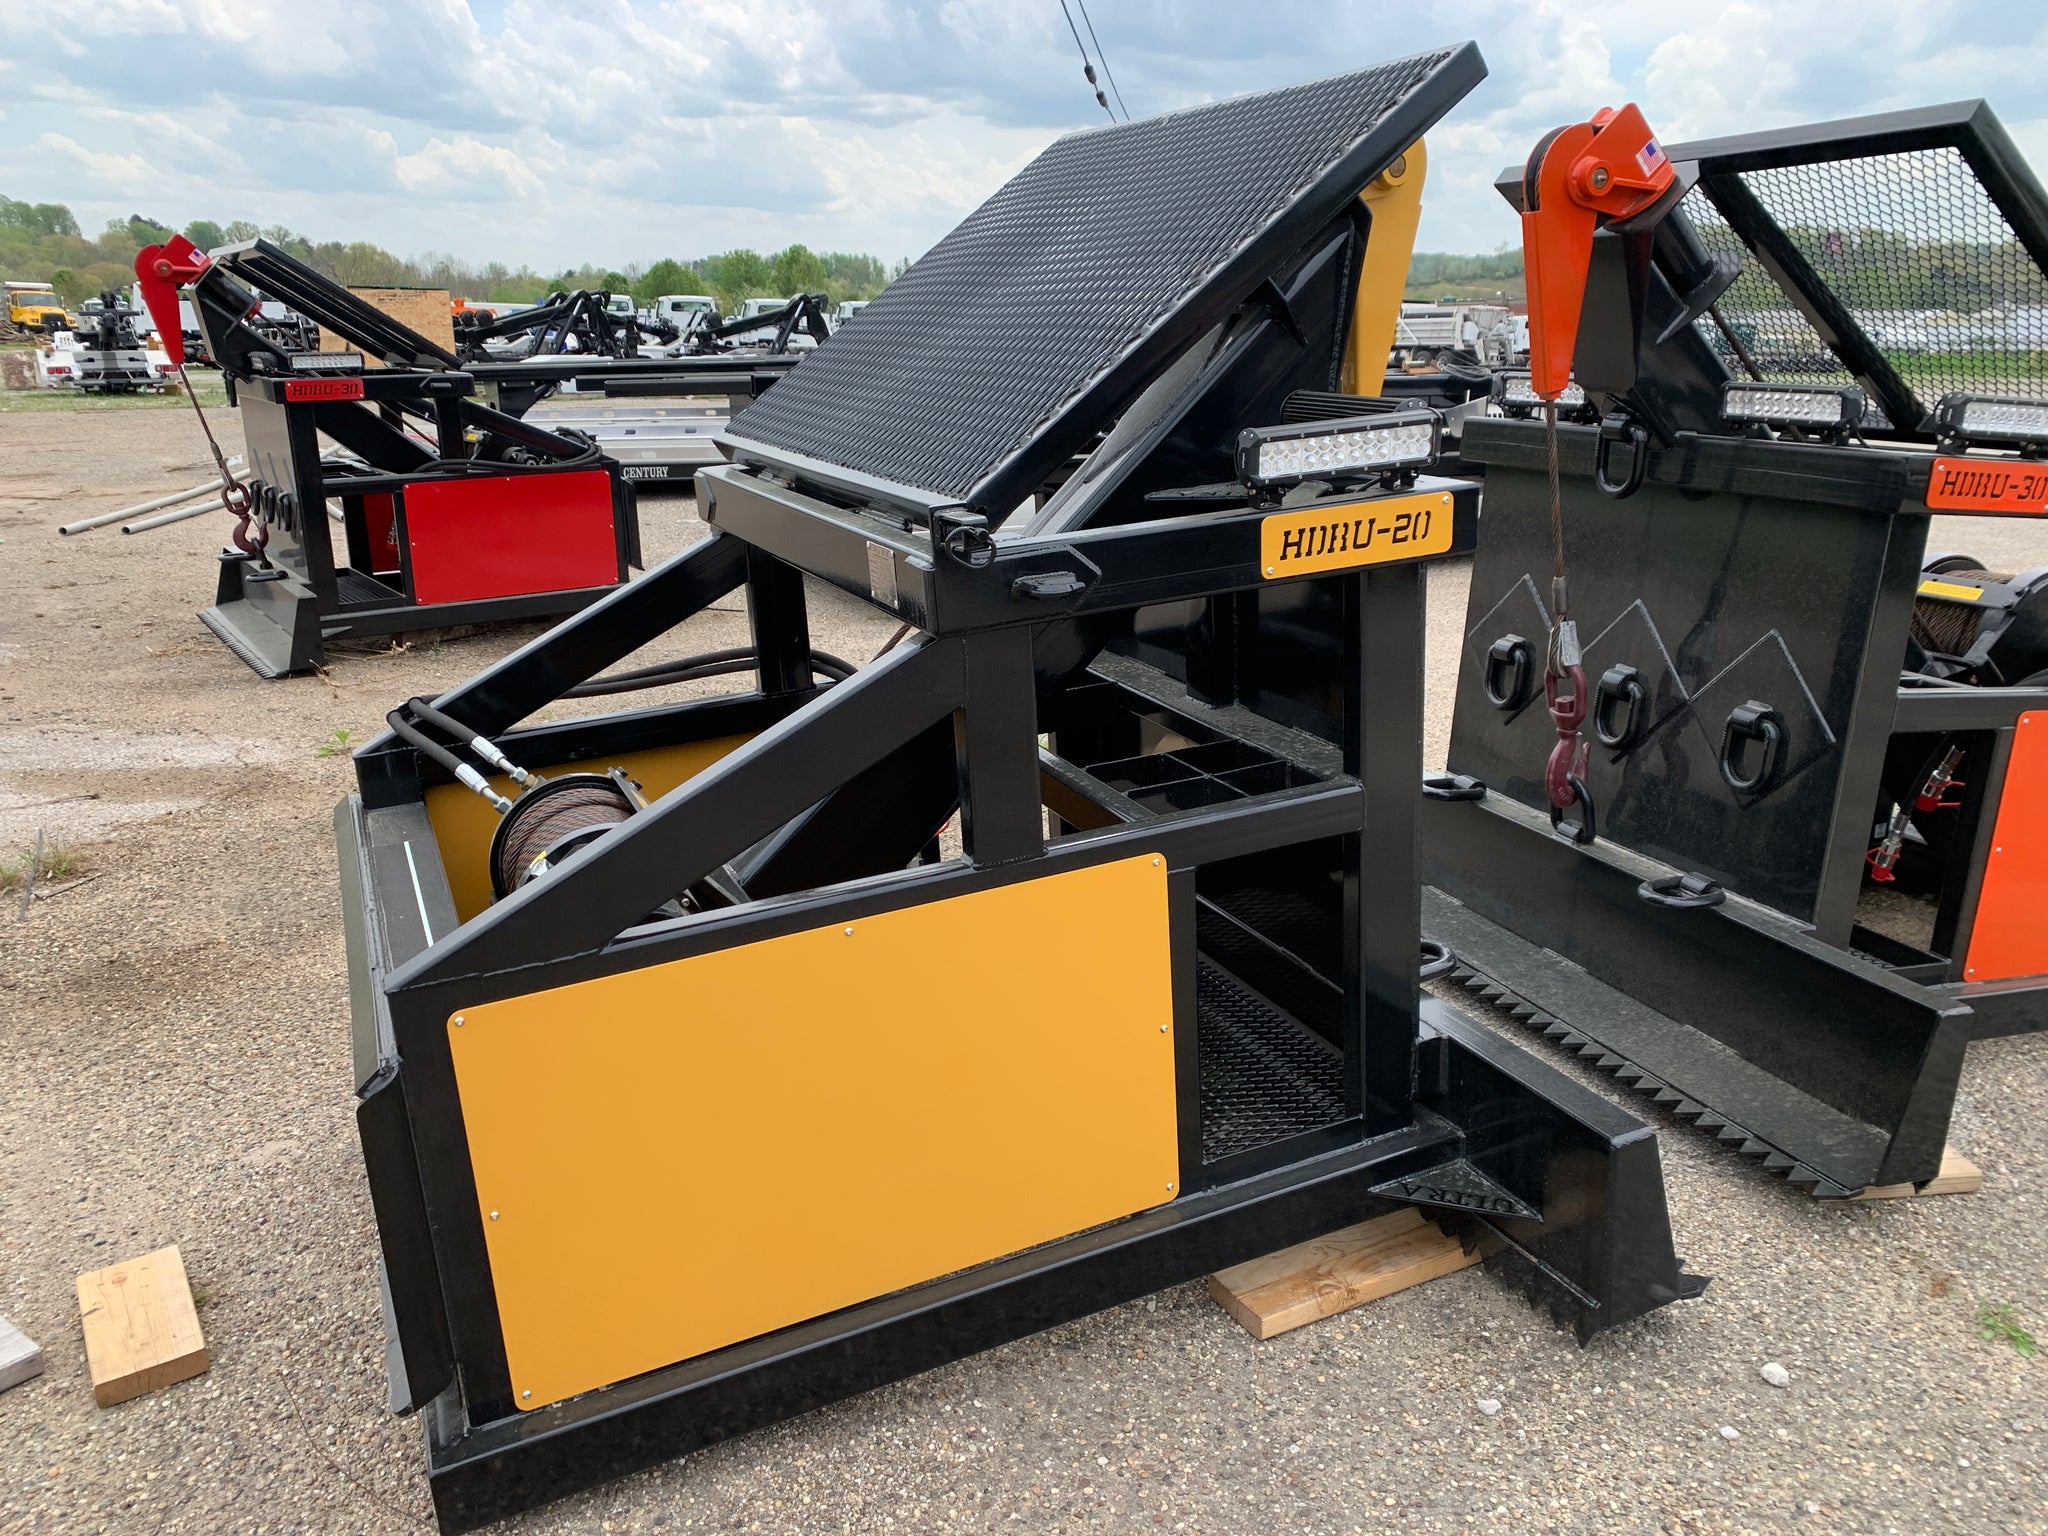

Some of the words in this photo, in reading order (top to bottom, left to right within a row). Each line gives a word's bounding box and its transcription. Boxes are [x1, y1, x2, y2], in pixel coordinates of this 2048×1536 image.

[292, 383, 358, 396] HDRU-30
[623, 466, 669, 478] CENTURY
[1939, 470, 2048, 500] HDRU-30
[1279, 510, 1432, 561] HDRU-20
